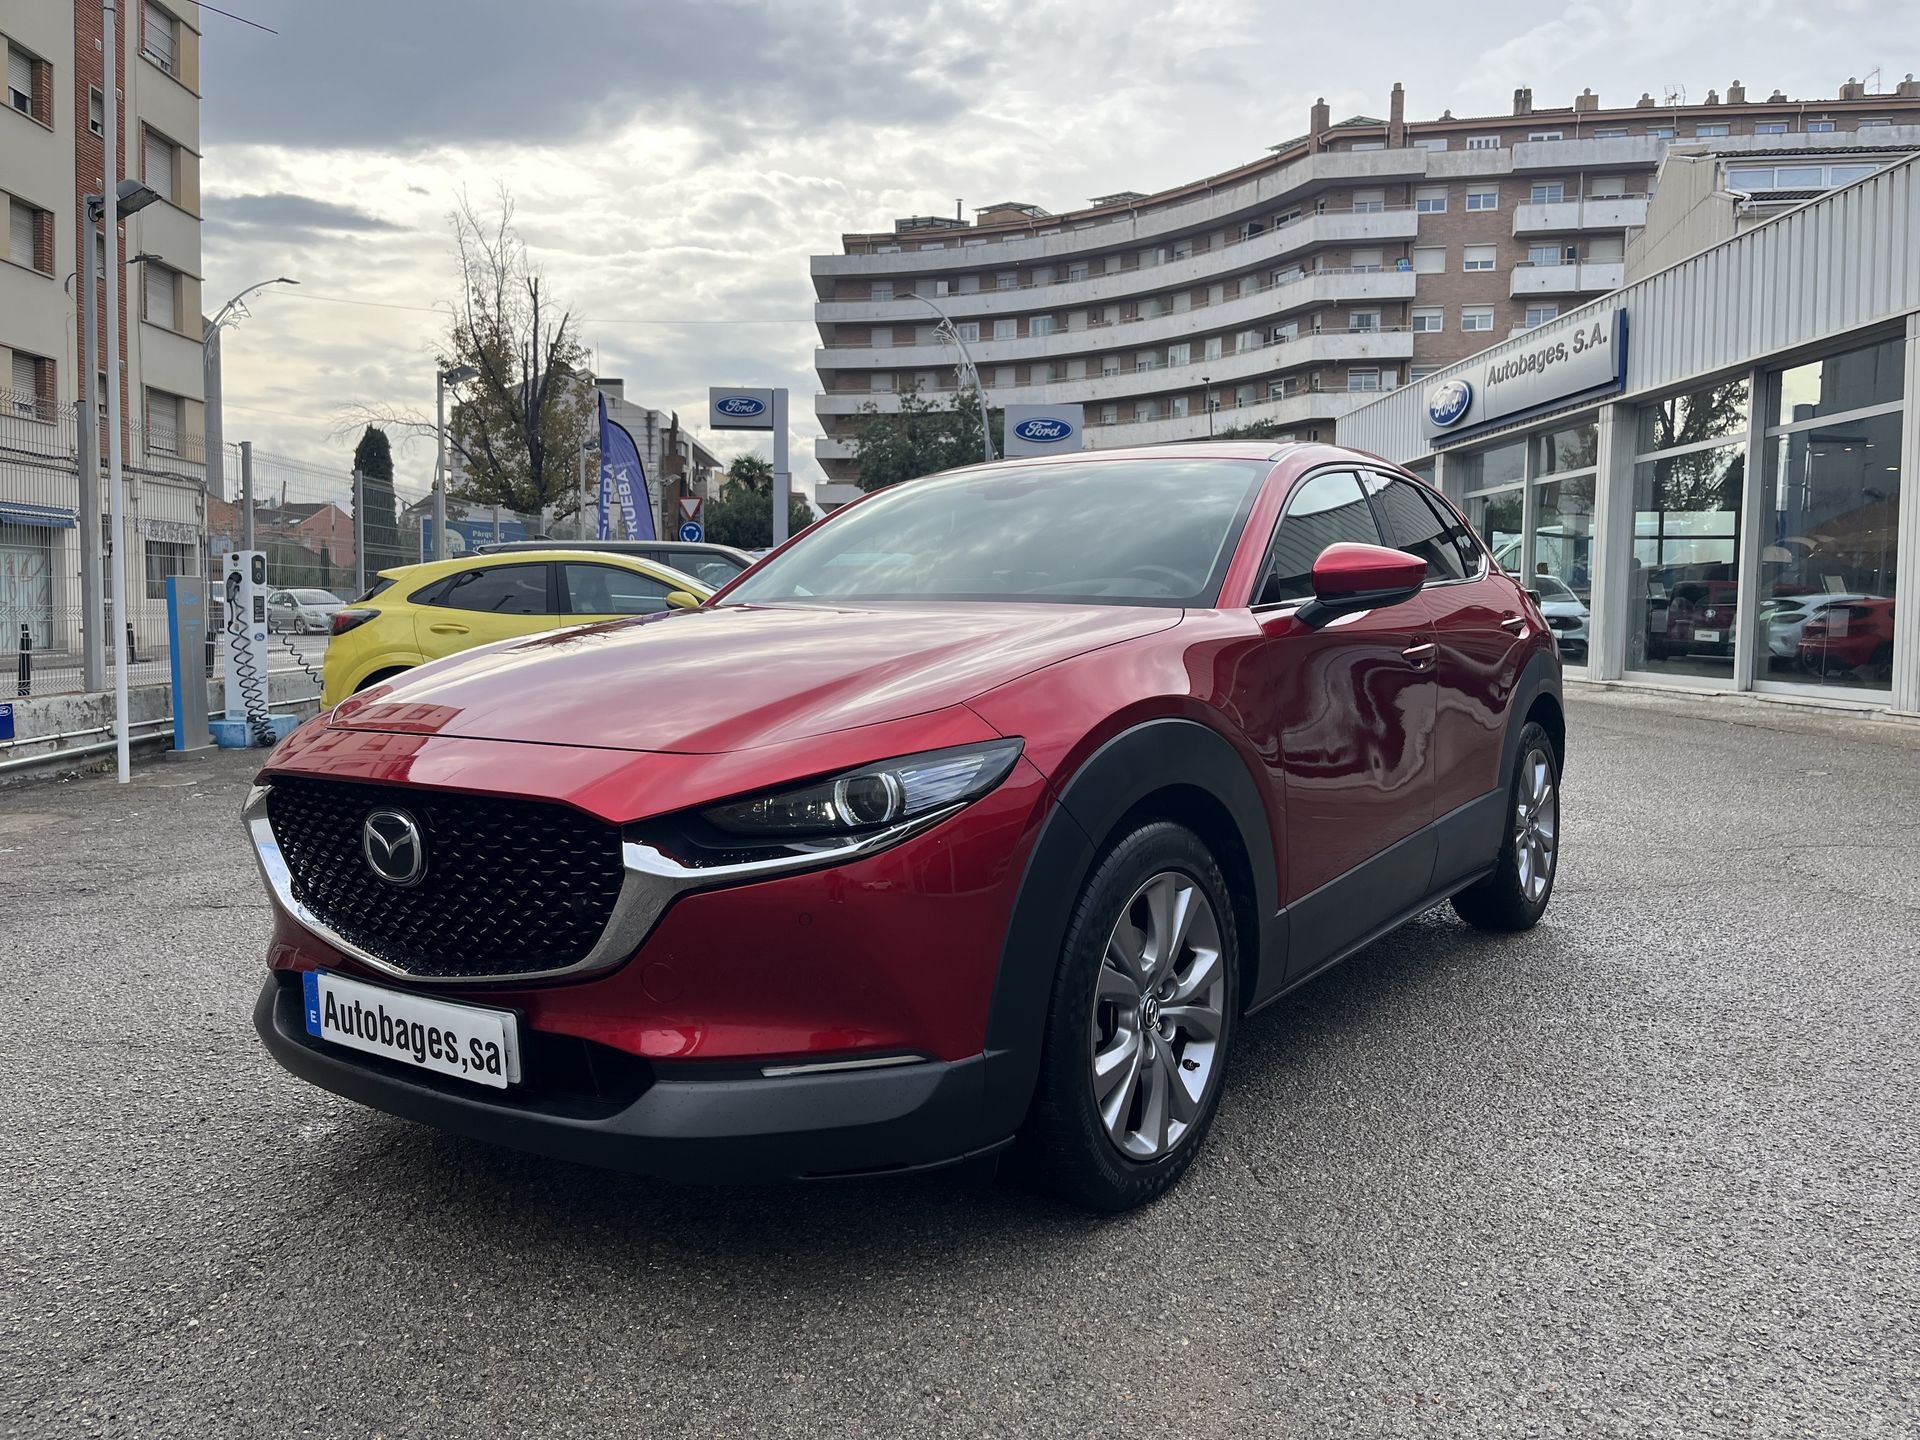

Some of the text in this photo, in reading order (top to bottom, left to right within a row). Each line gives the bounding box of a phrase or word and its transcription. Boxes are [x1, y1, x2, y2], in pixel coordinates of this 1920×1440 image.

[1486, 322, 1608, 387] Autobages, S.A.
[725, 399, 756, 413] Ford
[1025, 421, 1061, 437] Ford
[310, 1010, 318, 1023] E
[324, 991, 502, 1076] Autobages,sa
